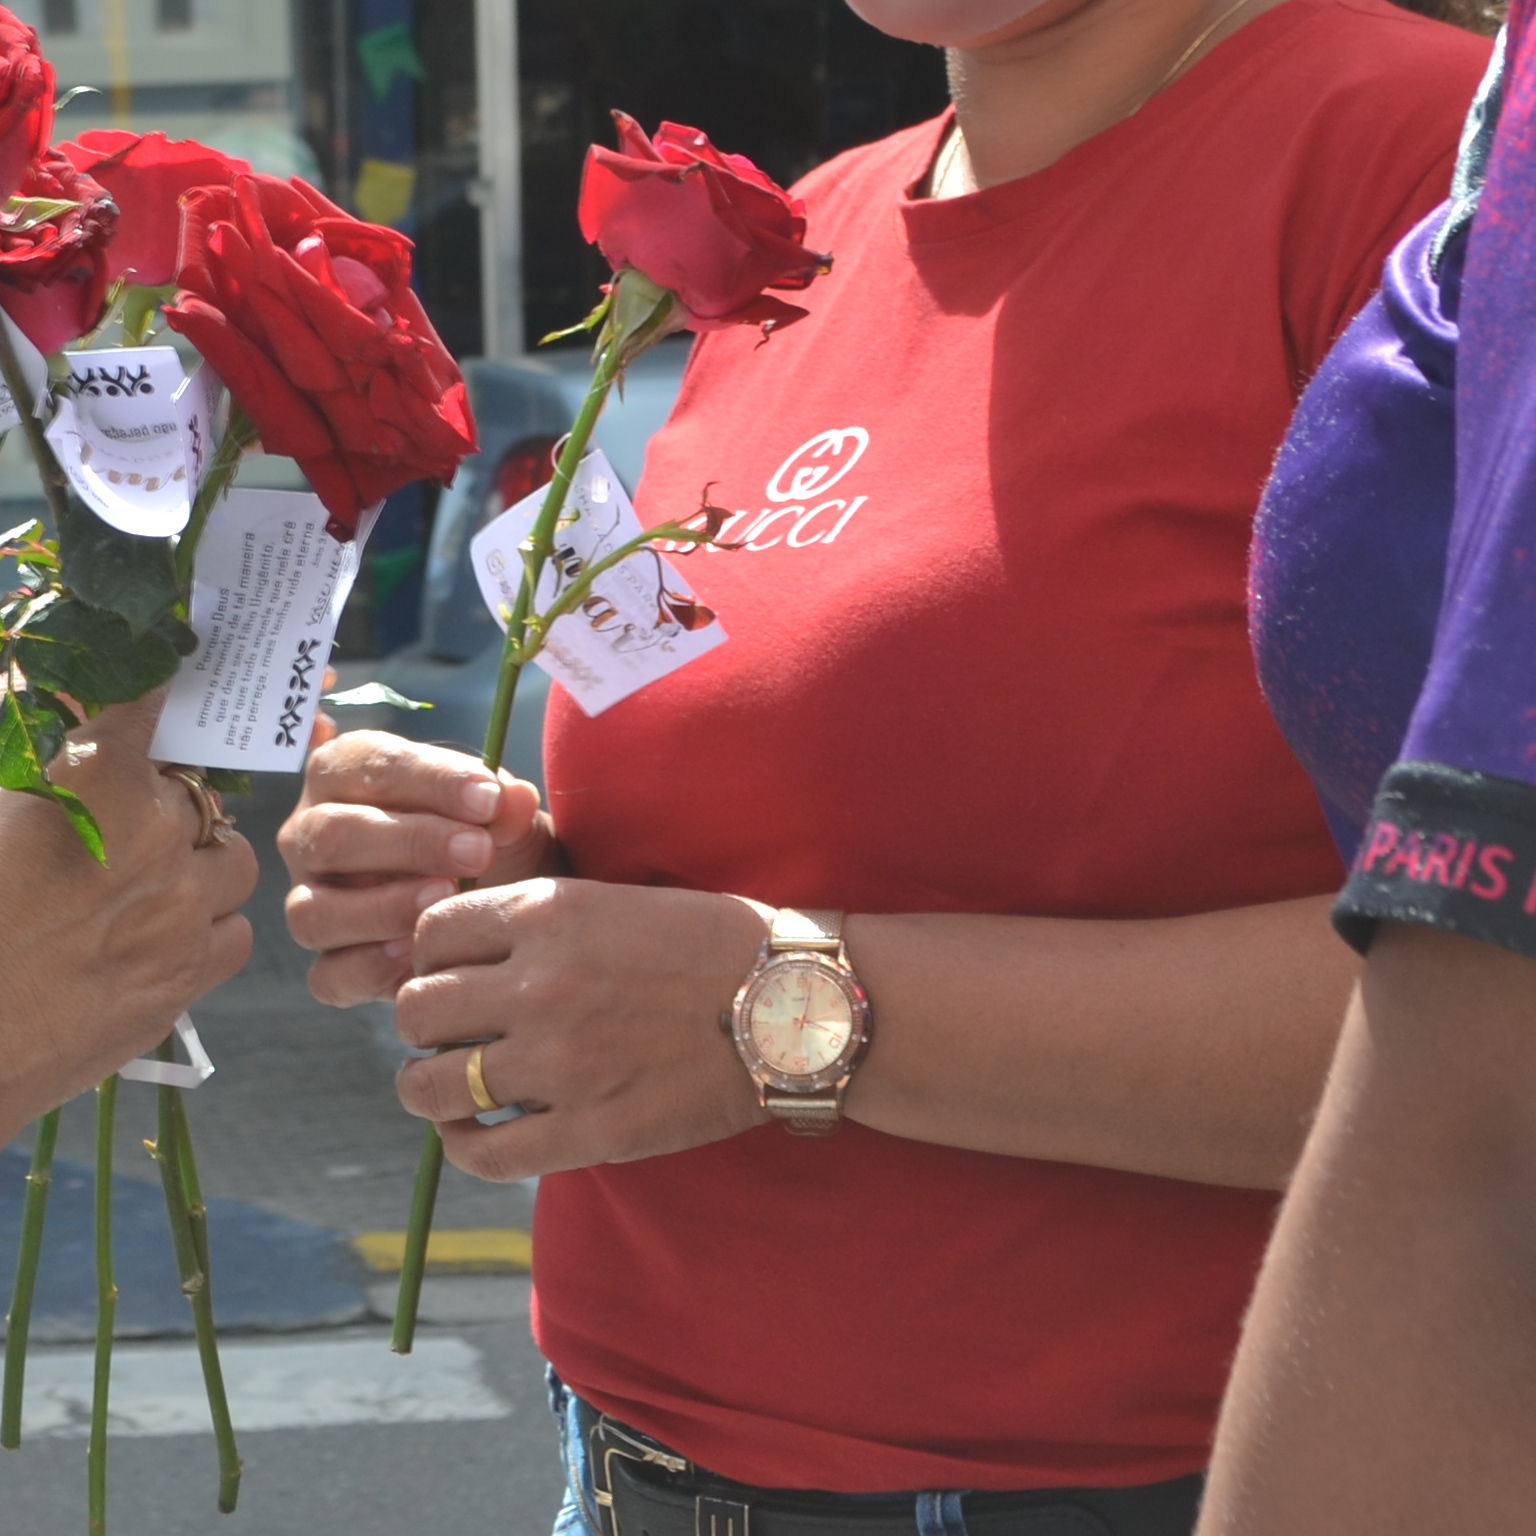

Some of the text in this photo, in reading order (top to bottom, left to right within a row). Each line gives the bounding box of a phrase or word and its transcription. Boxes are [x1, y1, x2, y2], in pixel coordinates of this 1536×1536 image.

[153, 422, 177, 434] não
[194, 587, 230, 671] Porque Deus
[196, 531, 256, 728] amou o mundo de tal maneira
[223, 520, 297, 744] para que todo aquele que nele crê
[231, 643, 246, 667] seu
[238, 725, 253, 750] não
[261, 638, 277, 667] mas
[269, 600, 292, 635] tenha
[286, 570, 302, 596] vida
[214, 698, 229, 723] que
[221, 671, 238, 695] deu
[1363, 820, 1515, 901] PARIS
